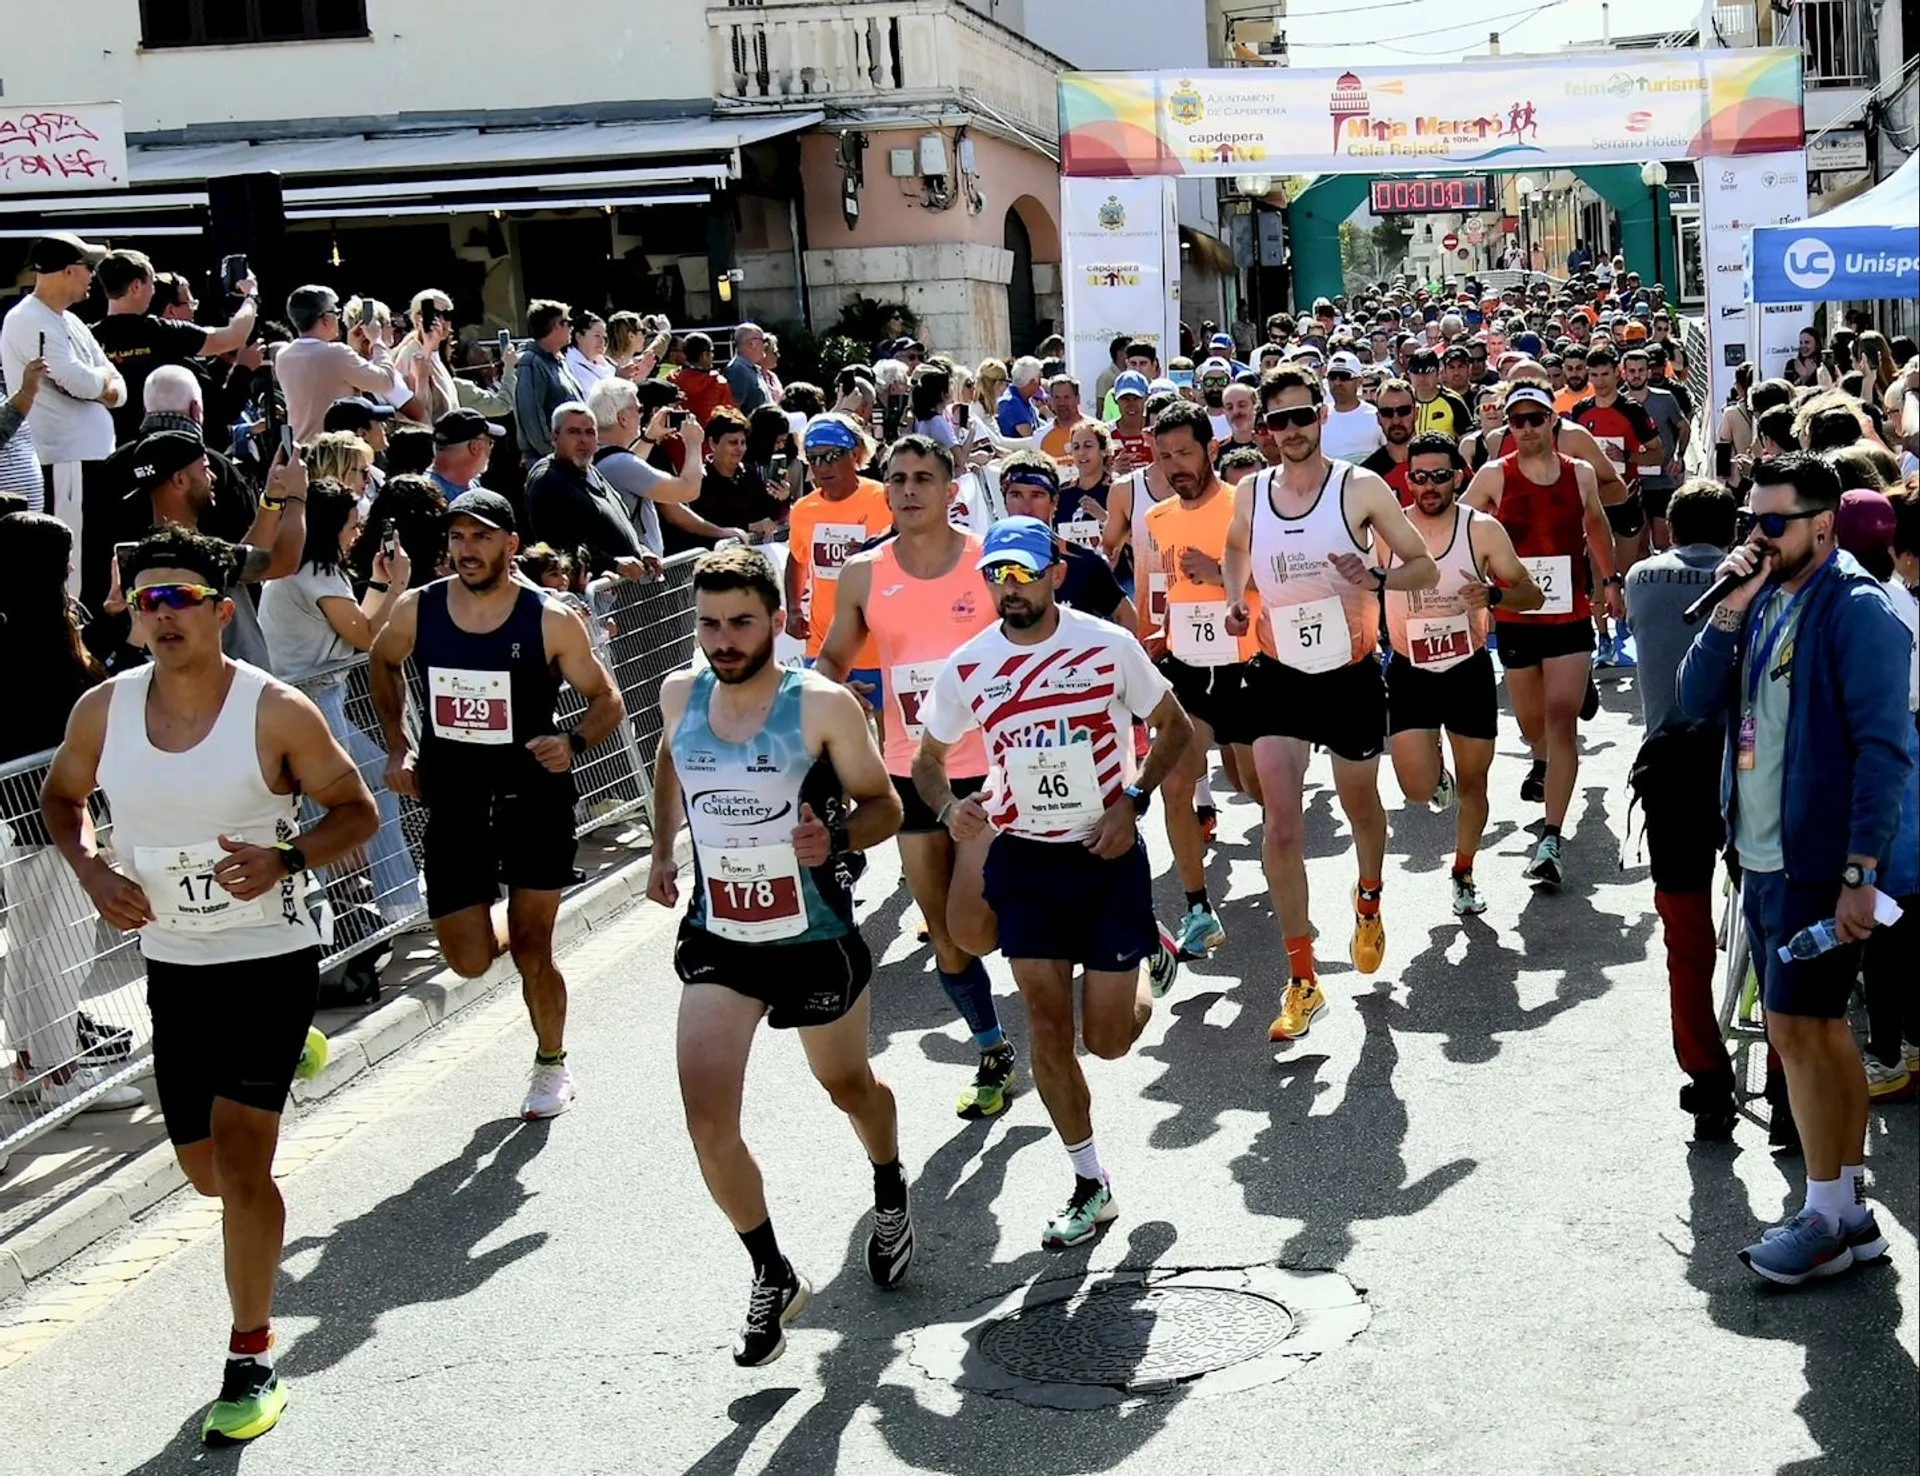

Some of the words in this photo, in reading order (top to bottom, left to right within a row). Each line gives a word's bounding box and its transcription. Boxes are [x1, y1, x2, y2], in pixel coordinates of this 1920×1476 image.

[1223, 106, 1287, 116] CAPDEPERA
[1189, 131, 1265, 144] capdepera
[1591, 137, 1643, 150] Serrano
[1647, 131, 1688, 147] Hotels
[1347, 144, 1385, 157] Cala
[1390, 141, 1450, 159] Rajada
[1086, 263, 1139, 273] capdepera
[1287, 551, 1306, 562] club
[1289, 560, 1330, 571] atletisme
[1191, 622, 1215, 643] 78
[1300, 624, 1322, 648] 57
[1424, 633, 1454, 655] 171
[451, 698, 490, 721] 129
[1038, 774, 1069, 799] 46
[702, 801, 772, 820] Caldentey
[179, 873, 213, 902] 17
[723, 880, 775, 910] 178
